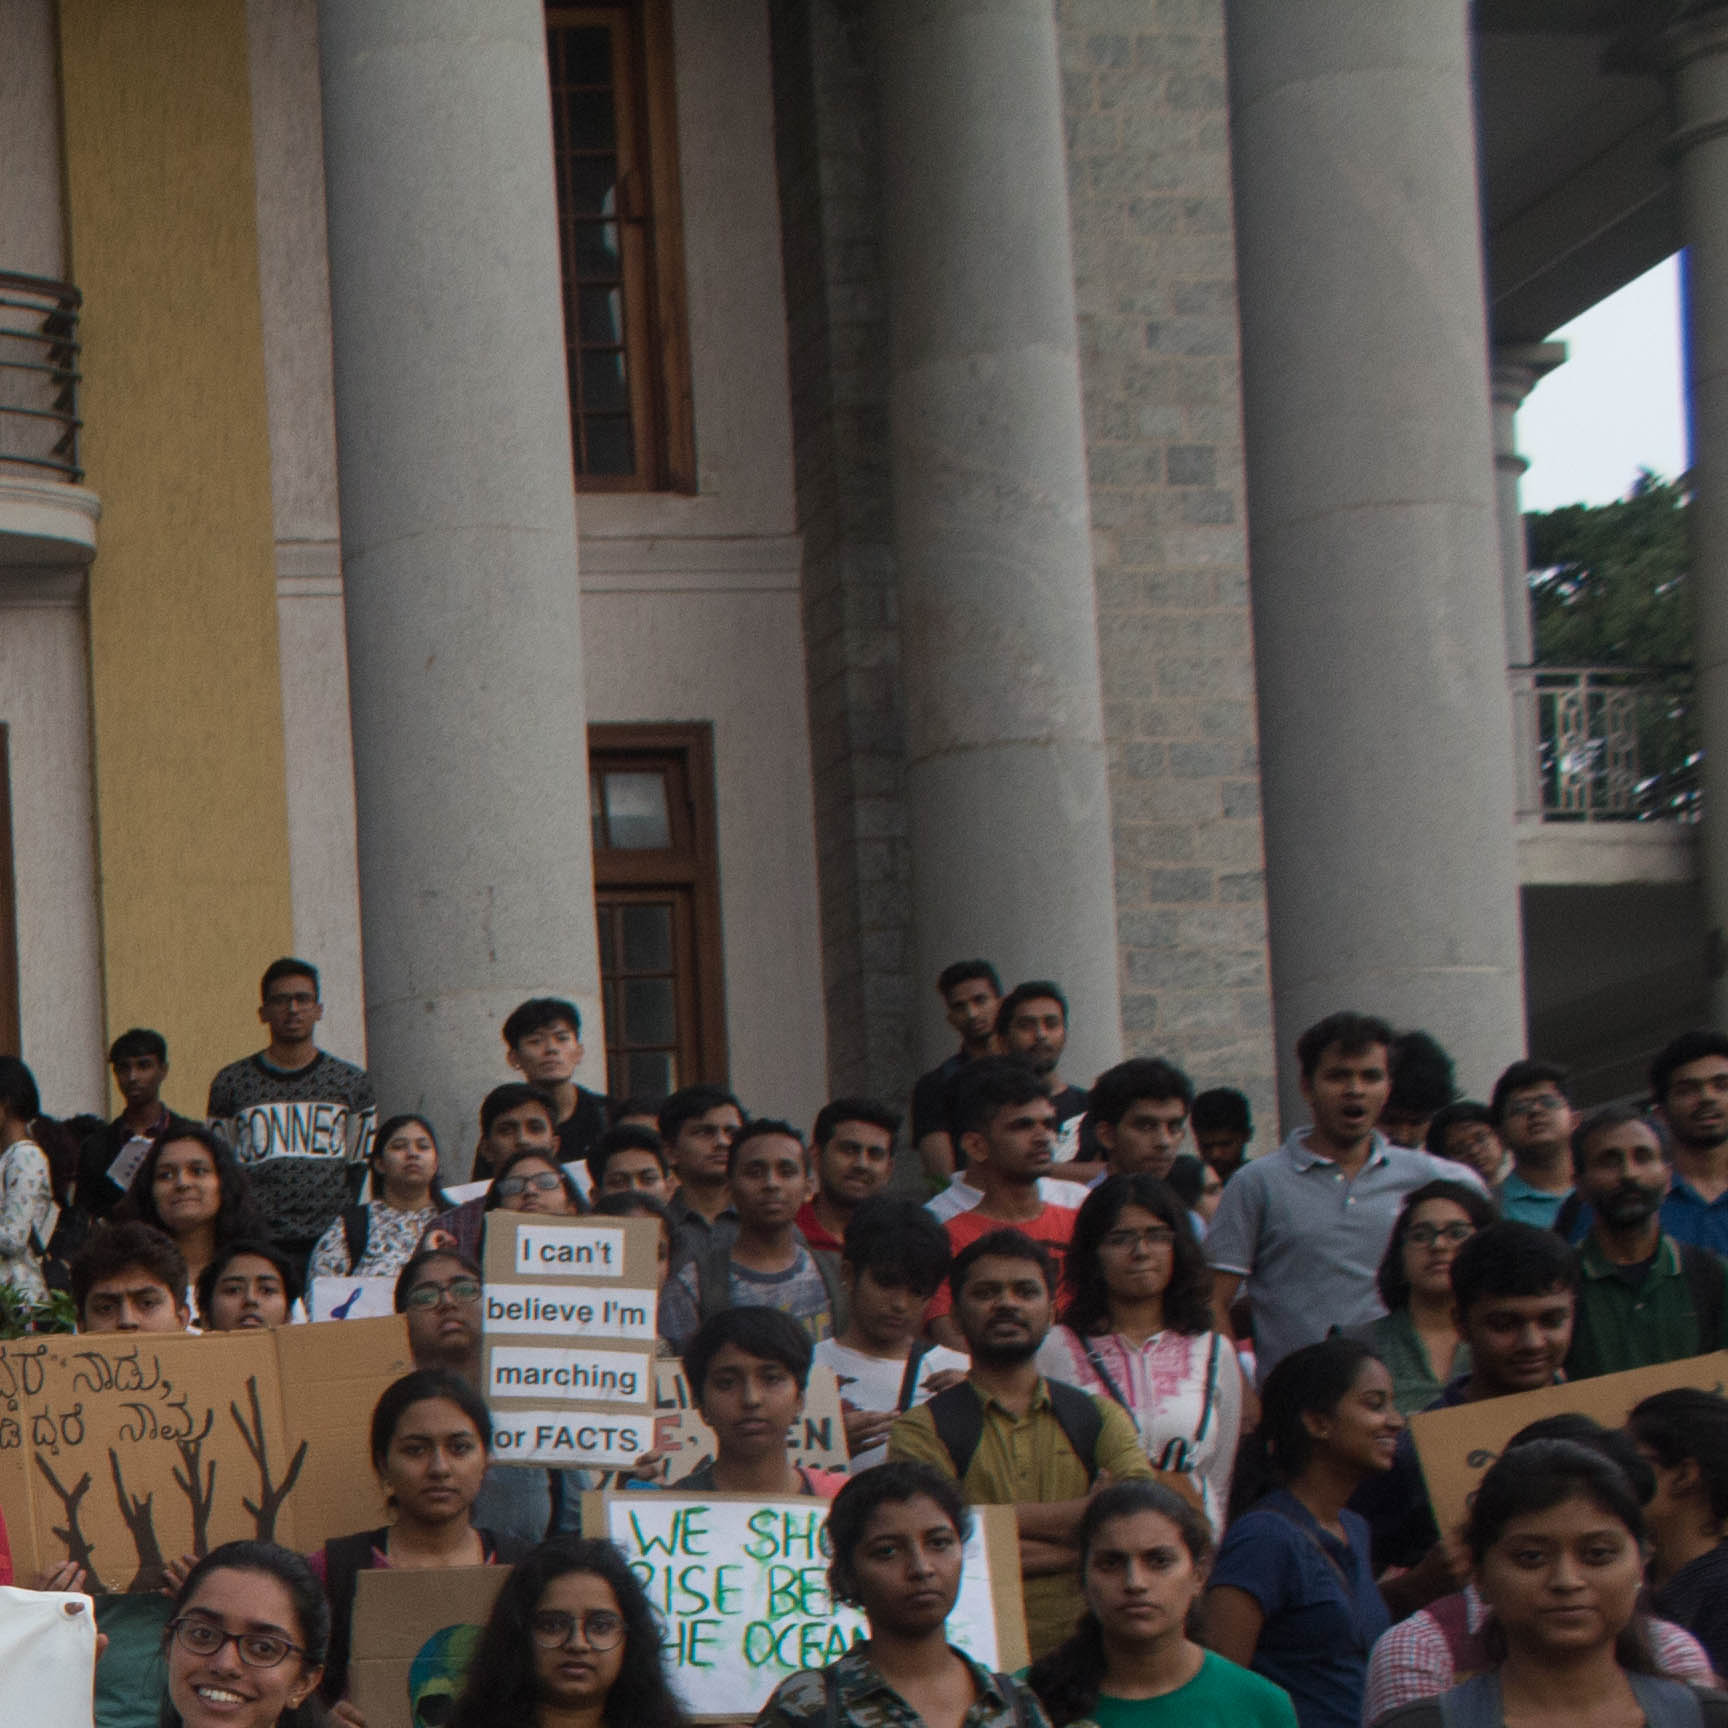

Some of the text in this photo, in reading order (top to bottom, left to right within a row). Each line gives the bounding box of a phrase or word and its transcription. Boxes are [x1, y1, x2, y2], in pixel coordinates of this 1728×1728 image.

[523, 1239, 612, 1264] I can't
[486, 1296, 646, 1325] believe I'm
[495, 1363, 637, 1396] marching
[490, 1428, 525, 1449] or
[629, 1506, 832, 1561] WE SH
[767, 1564, 836, 1619] BE
[662, 1619, 872, 1669] HE OCEA
